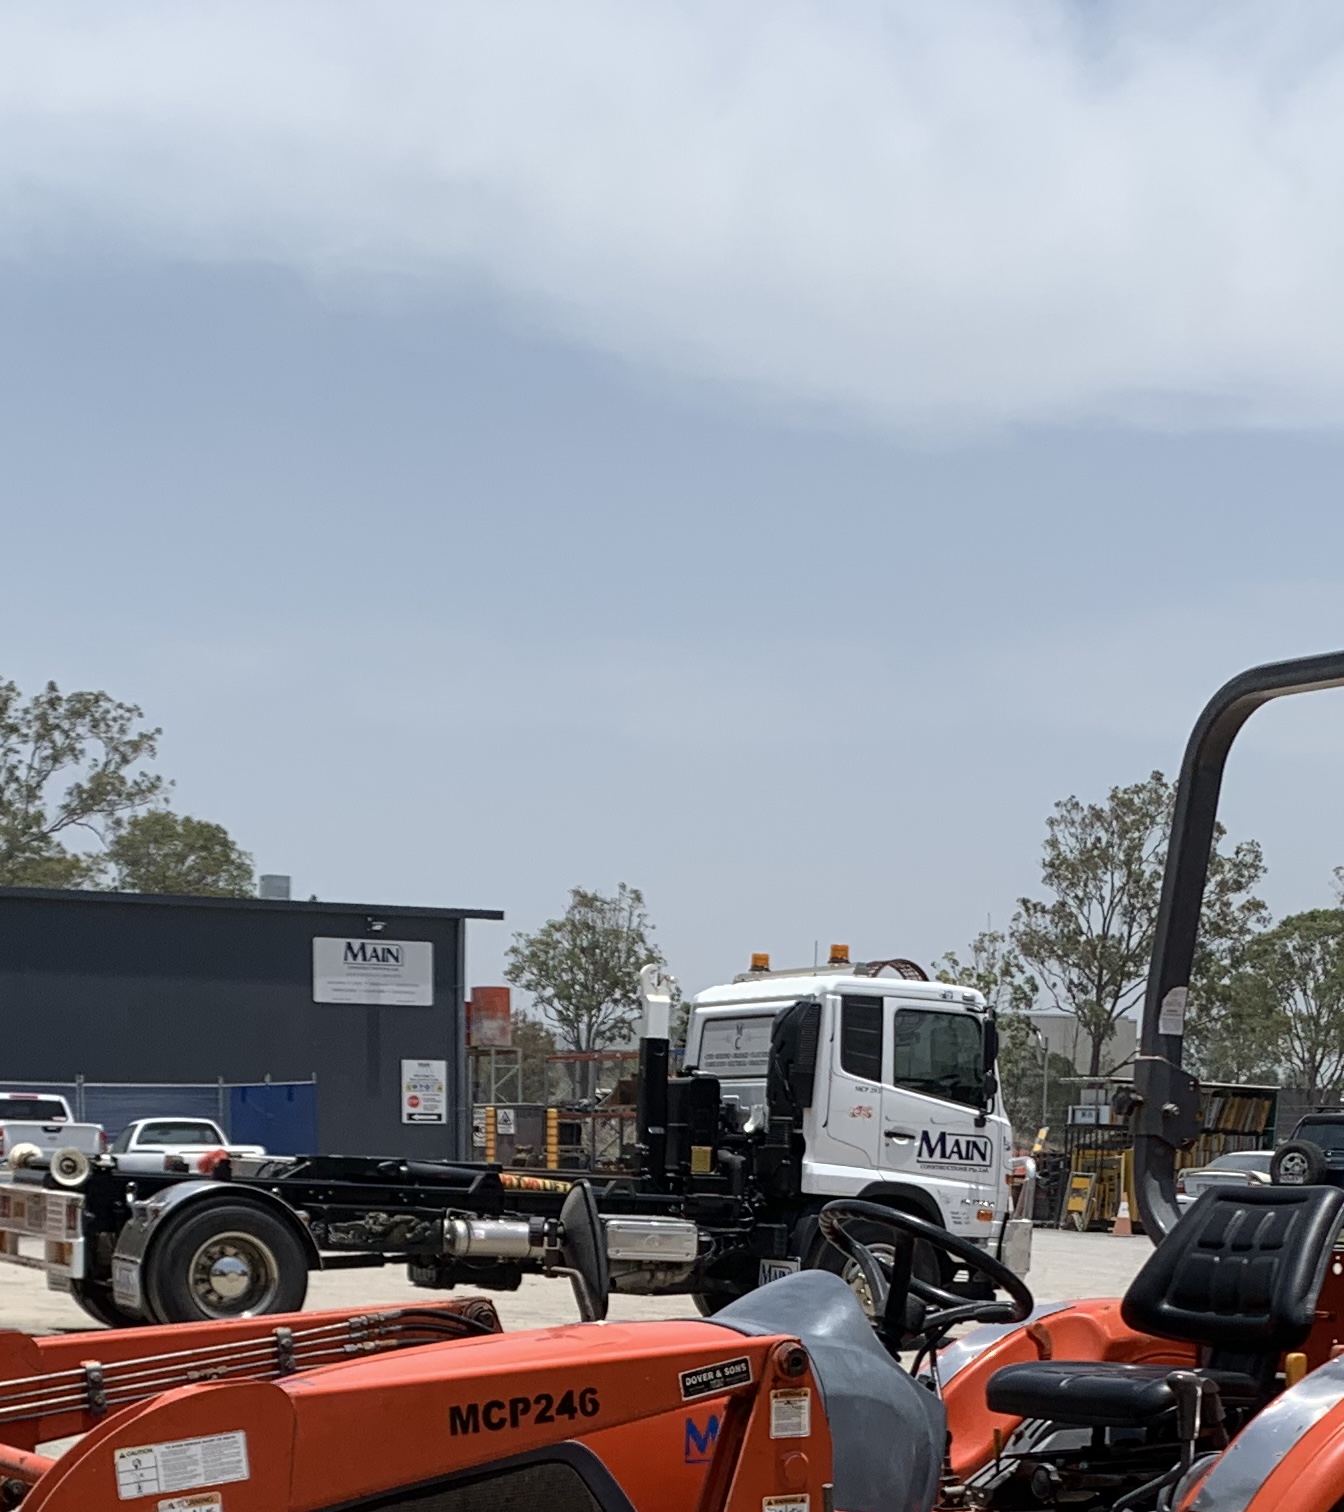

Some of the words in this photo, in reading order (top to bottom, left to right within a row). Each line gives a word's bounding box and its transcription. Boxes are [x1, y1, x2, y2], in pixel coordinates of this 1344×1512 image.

[344, 941, 400, 963] MAIN
[917, 1130, 989, 1162] MAIN
[685, 1371, 714, 1386] DOVER
[715, 1369, 723, 1378] &
[724, 1362, 748, 1376] SONS
[449, 1387, 601, 1436] MCP246
